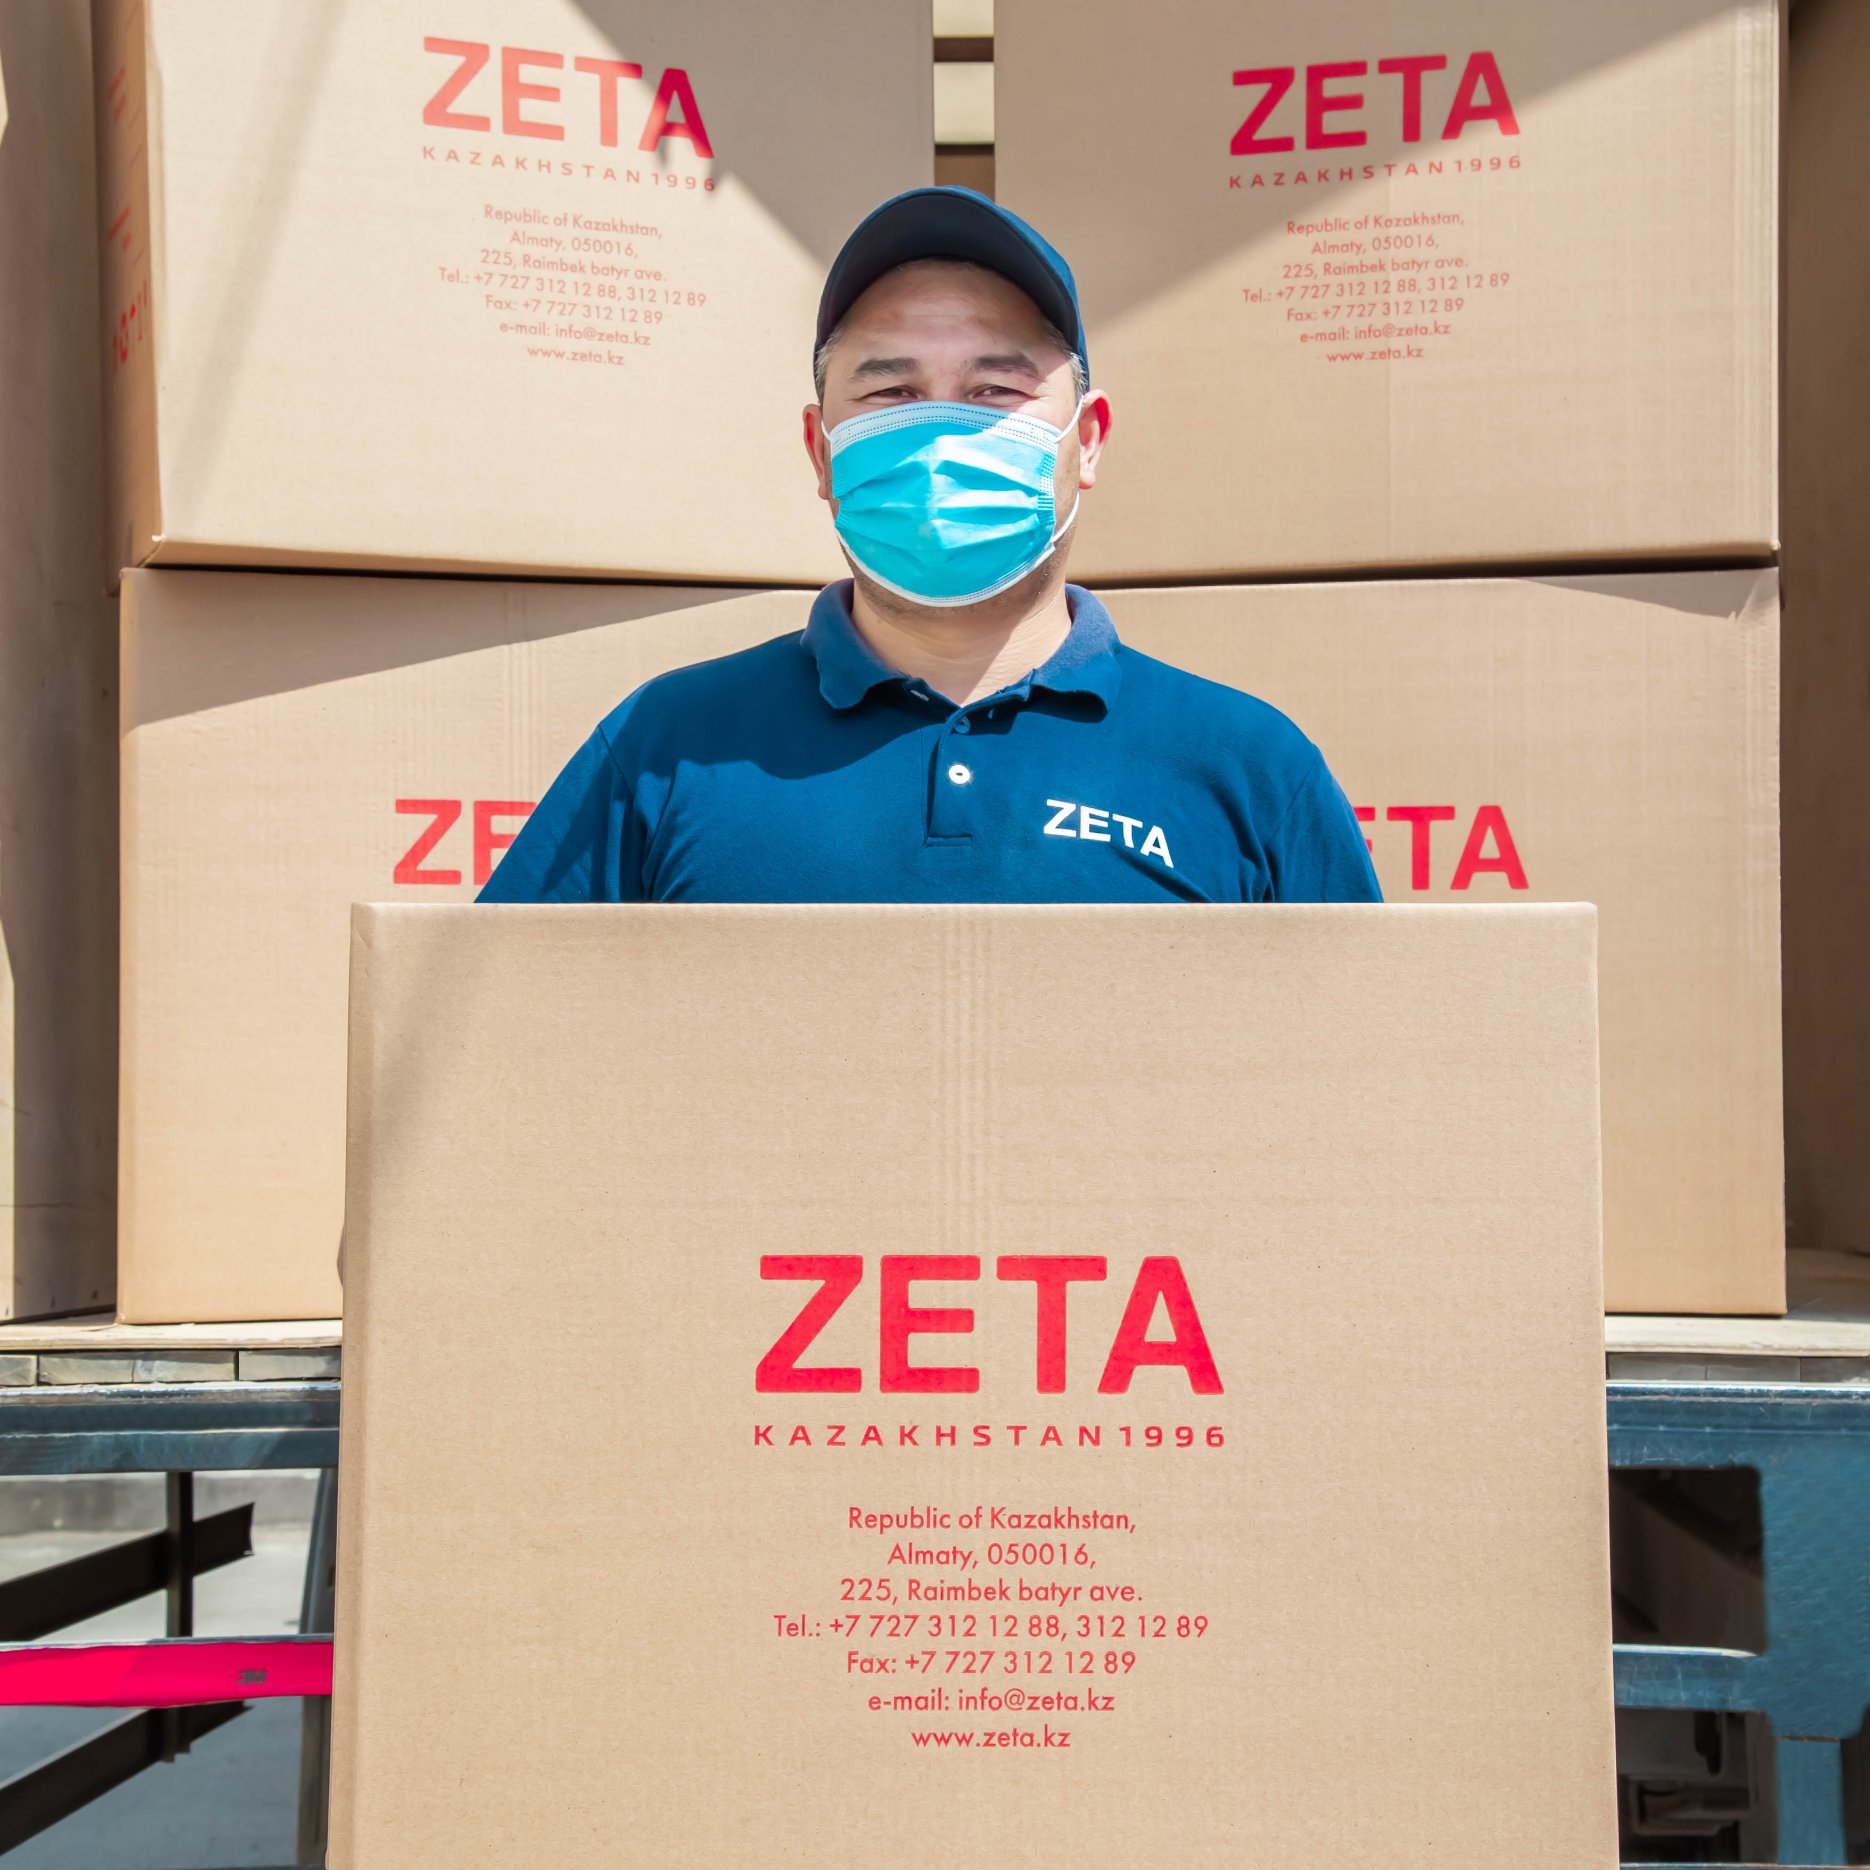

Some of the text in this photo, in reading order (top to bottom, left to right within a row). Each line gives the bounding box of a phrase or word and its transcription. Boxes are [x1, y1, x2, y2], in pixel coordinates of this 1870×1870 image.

[423, 36, 715, 159] ZETA
[1230, 51, 1520, 156] ZETA
[484, 205, 662, 240] Republic of Kazakhstan,
[1286, 212, 1465, 237] Republic of Kazakhstan,
[510, 231, 638, 259] Almaty, 050016,
[1311, 234, 1440, 256] Almaty, 050016,
[480, 249, 667, 282] 225, Raimbek batyr ave.
[1283, 257, 1468, 280] 225, Raimbek batyr ave.
[438, 267, 707, 307] Tel.: +7 727 312 12 88, 312 12 89
[1243, 272, 1510, 303] Tel.: +7 727 312 12 88, 312 12 89
[485, 295, 663, 325] Fax: +7 727 312 12 89
[1287, 298, 1464, 322] Fax: +7 727 312 12 89
[499, 321, 650, 346] e-mail: info@zeta.kz
[1300, 320, 1451, 343] e-mail: info@zeta.kz
[527, 344, 624, 366] www.zeta.kz
[1328, 347, 1424, 363] www.zeta.kz
[393, 798, 538, 886] ZE
[1043, 798, 1175, 868] ZETA
[755, 1255, 1224, 1394] ZETA
[849, 1506, 1135, 1534] Republic of Kazakhstan,
[888, 1542, 1095, 1570] Almaty, 050016,
[841, 1577, 1142, 1607] 225, Raimbek batyr ave.
[774, 1615, 1208, 1641] Tel.: +7 727 312 12 88, 312 12 89
[848, 1650, 1136, 1674] Fax: +7 727 312 12 89
[237, 1669, 266, 1685] 3M
[868, 1687, 1114, 1711] e-mail: info@zeta.kz
[912, 1724, 1070, 1747] www.zeta.kz
